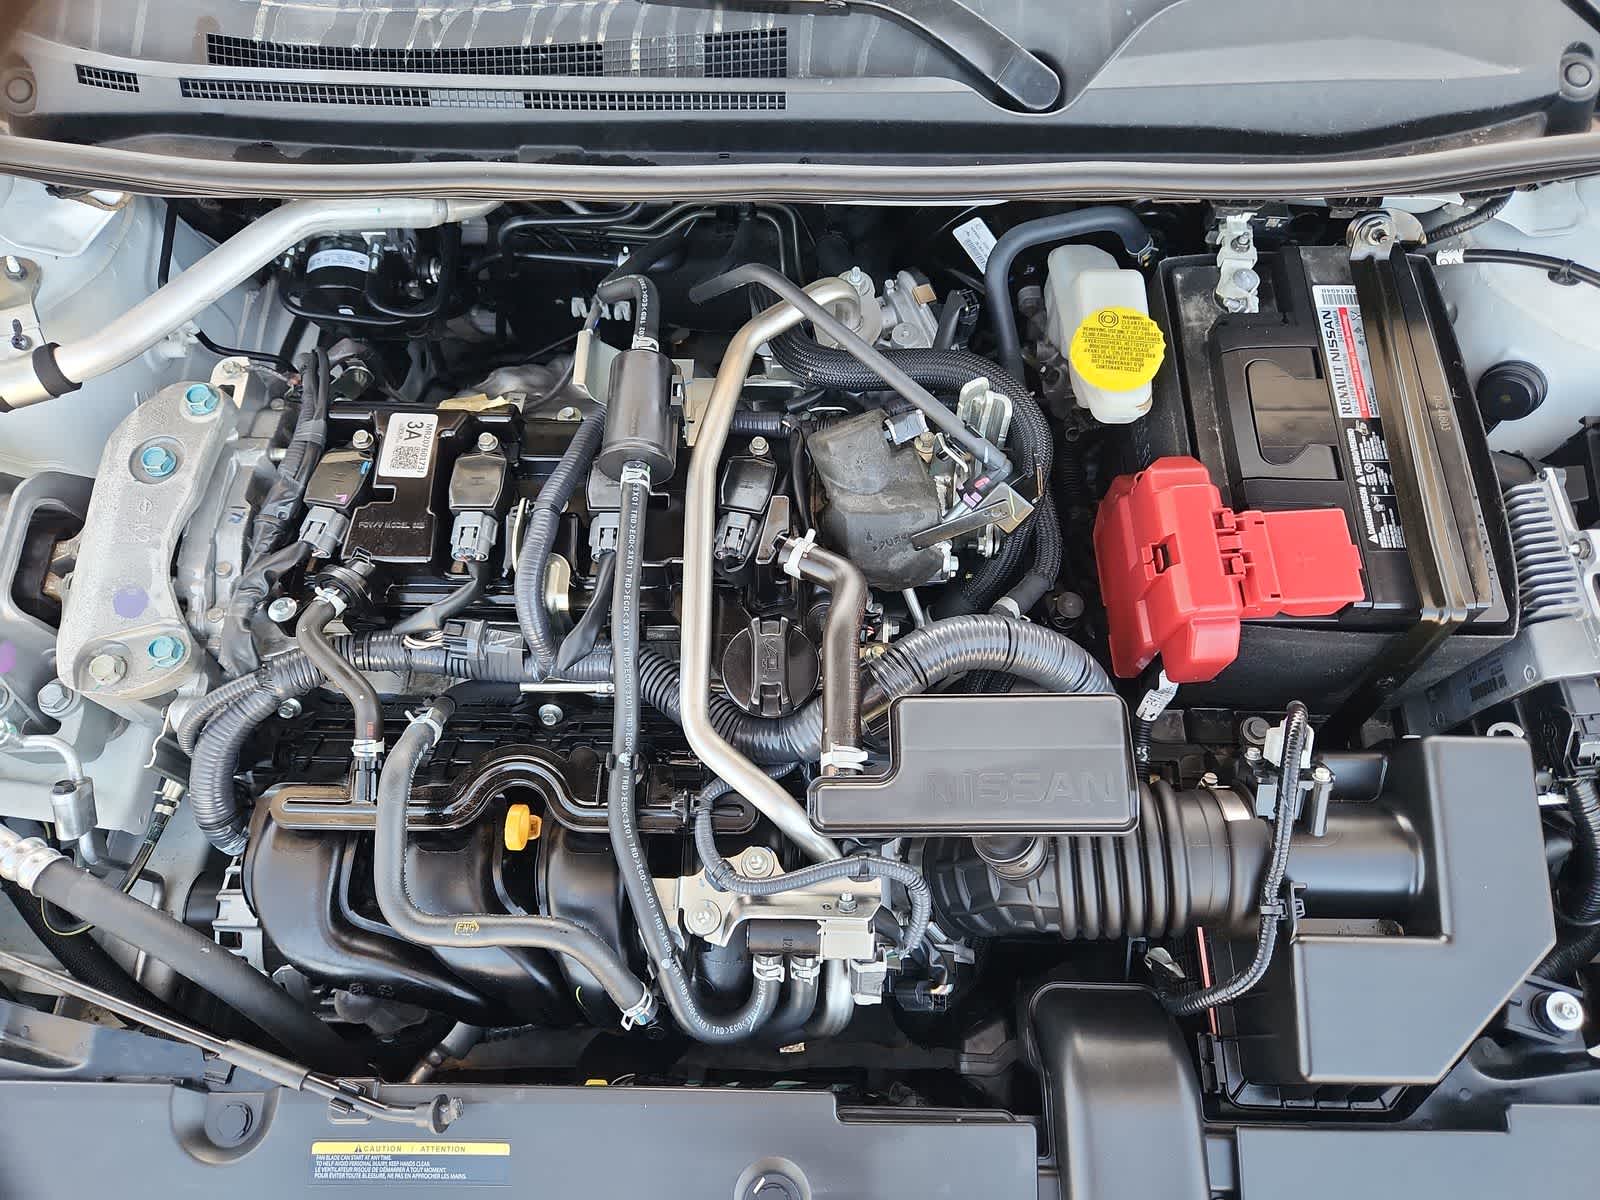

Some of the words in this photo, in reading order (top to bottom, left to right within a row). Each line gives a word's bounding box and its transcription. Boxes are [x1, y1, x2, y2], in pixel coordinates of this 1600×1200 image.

[1321, 310, 1341, 361] NISSAN
[1333, 365, 1352, 414] RENAULT
[404, 421, 424, 440] 3A
[922, 770, 1118, 805] NISSAN
